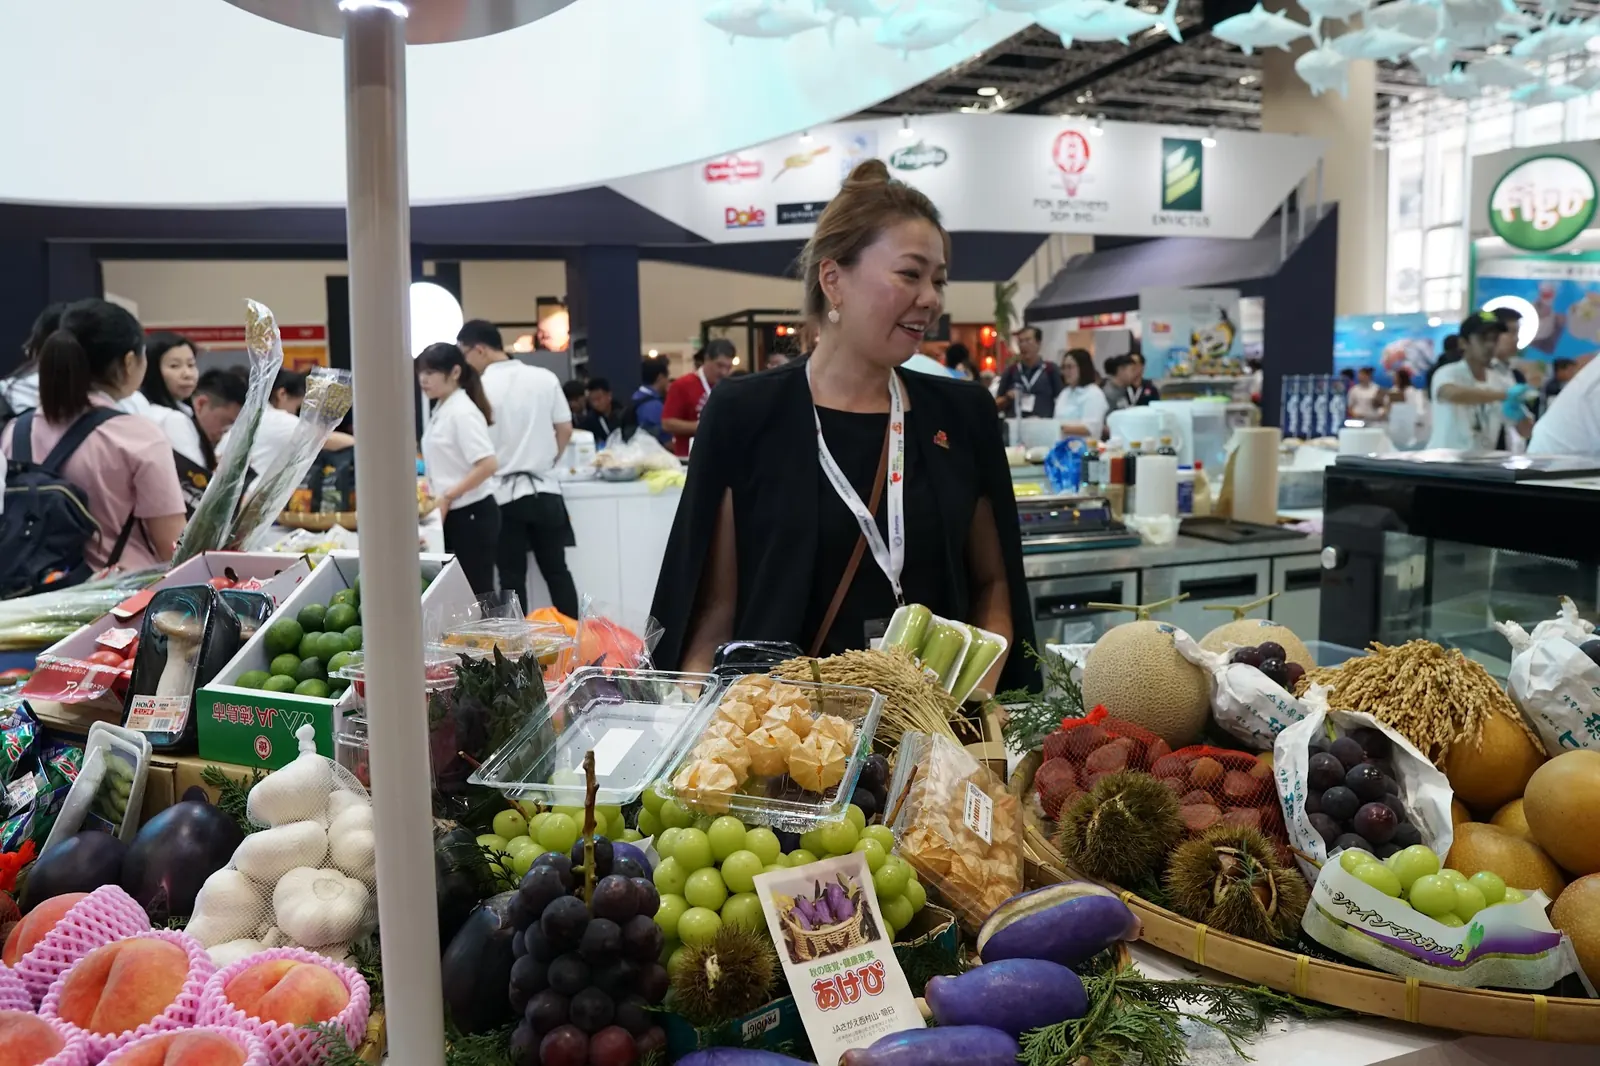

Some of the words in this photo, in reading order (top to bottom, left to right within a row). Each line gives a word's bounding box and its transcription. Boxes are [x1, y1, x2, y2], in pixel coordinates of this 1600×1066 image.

[725, 205, 765, 225] Dole
[1501, 185, 1585, 231] Figo
[212, 702, 254, 726] 徳島市
[255, 706, 278, 728] JA
[1331, 891, 1464, 961] シャインマスカット
[809, 950, 875, 977] 秋の味覚・健康果実
[811, 960, 885, 1011] あけび
[832, 1005, 896, 1035] JAさがえ西村山・朝日
